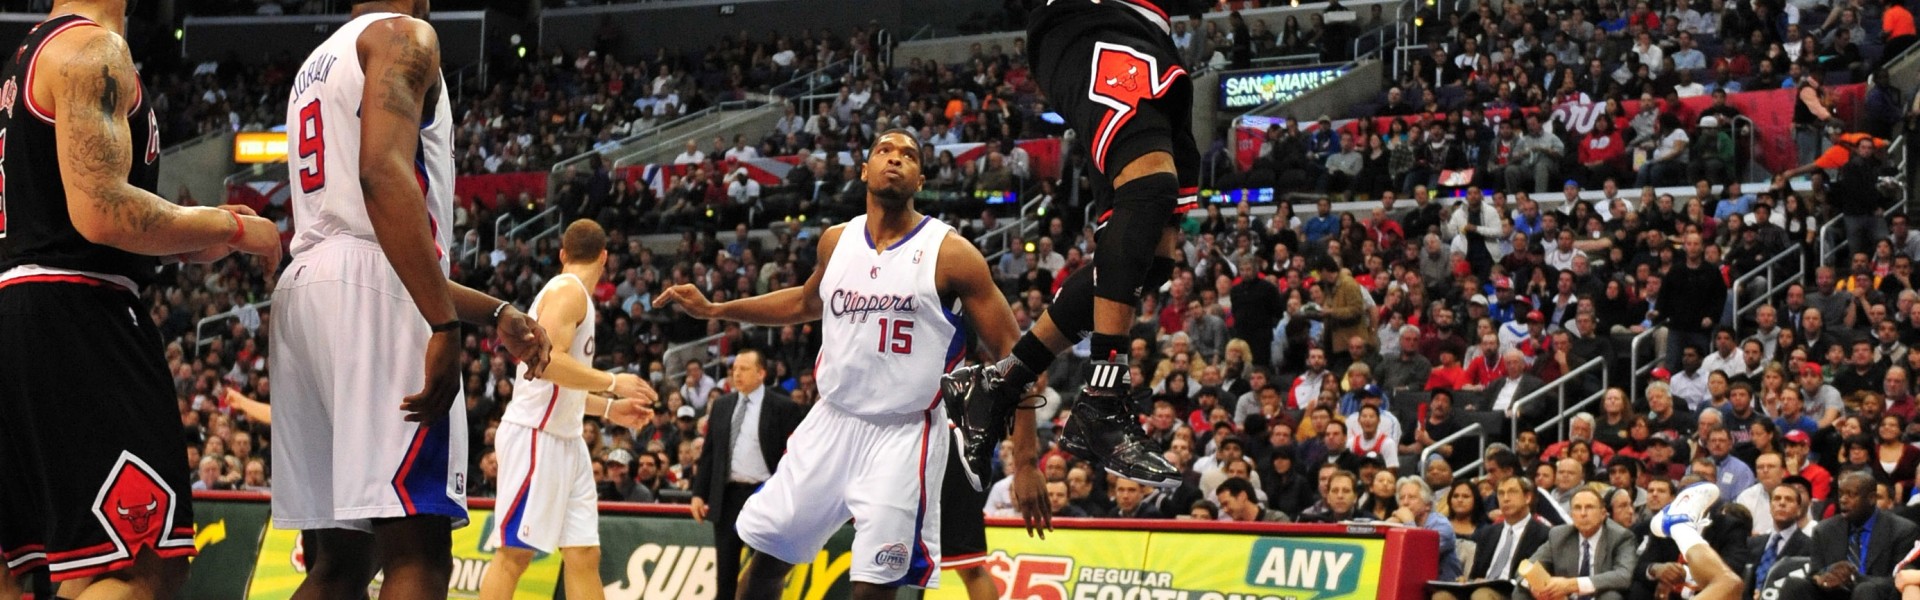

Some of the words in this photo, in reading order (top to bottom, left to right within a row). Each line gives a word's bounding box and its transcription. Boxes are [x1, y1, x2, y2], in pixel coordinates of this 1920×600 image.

[292, 53, 338, 104] JORAN
[1226, 77, 1261, 95] SAN
[1275, 69, 1343, 91] MANUE
[1226, 94, 1261, 107] INDIAN
[299, 97, 326, 194] 9
[830, 288, 918, 323] Clippers
[877, 317, 915, 355] 15
[1078, 566, 1173, 588] REGULAR
[1254, 546, 1354, 591] ANY
